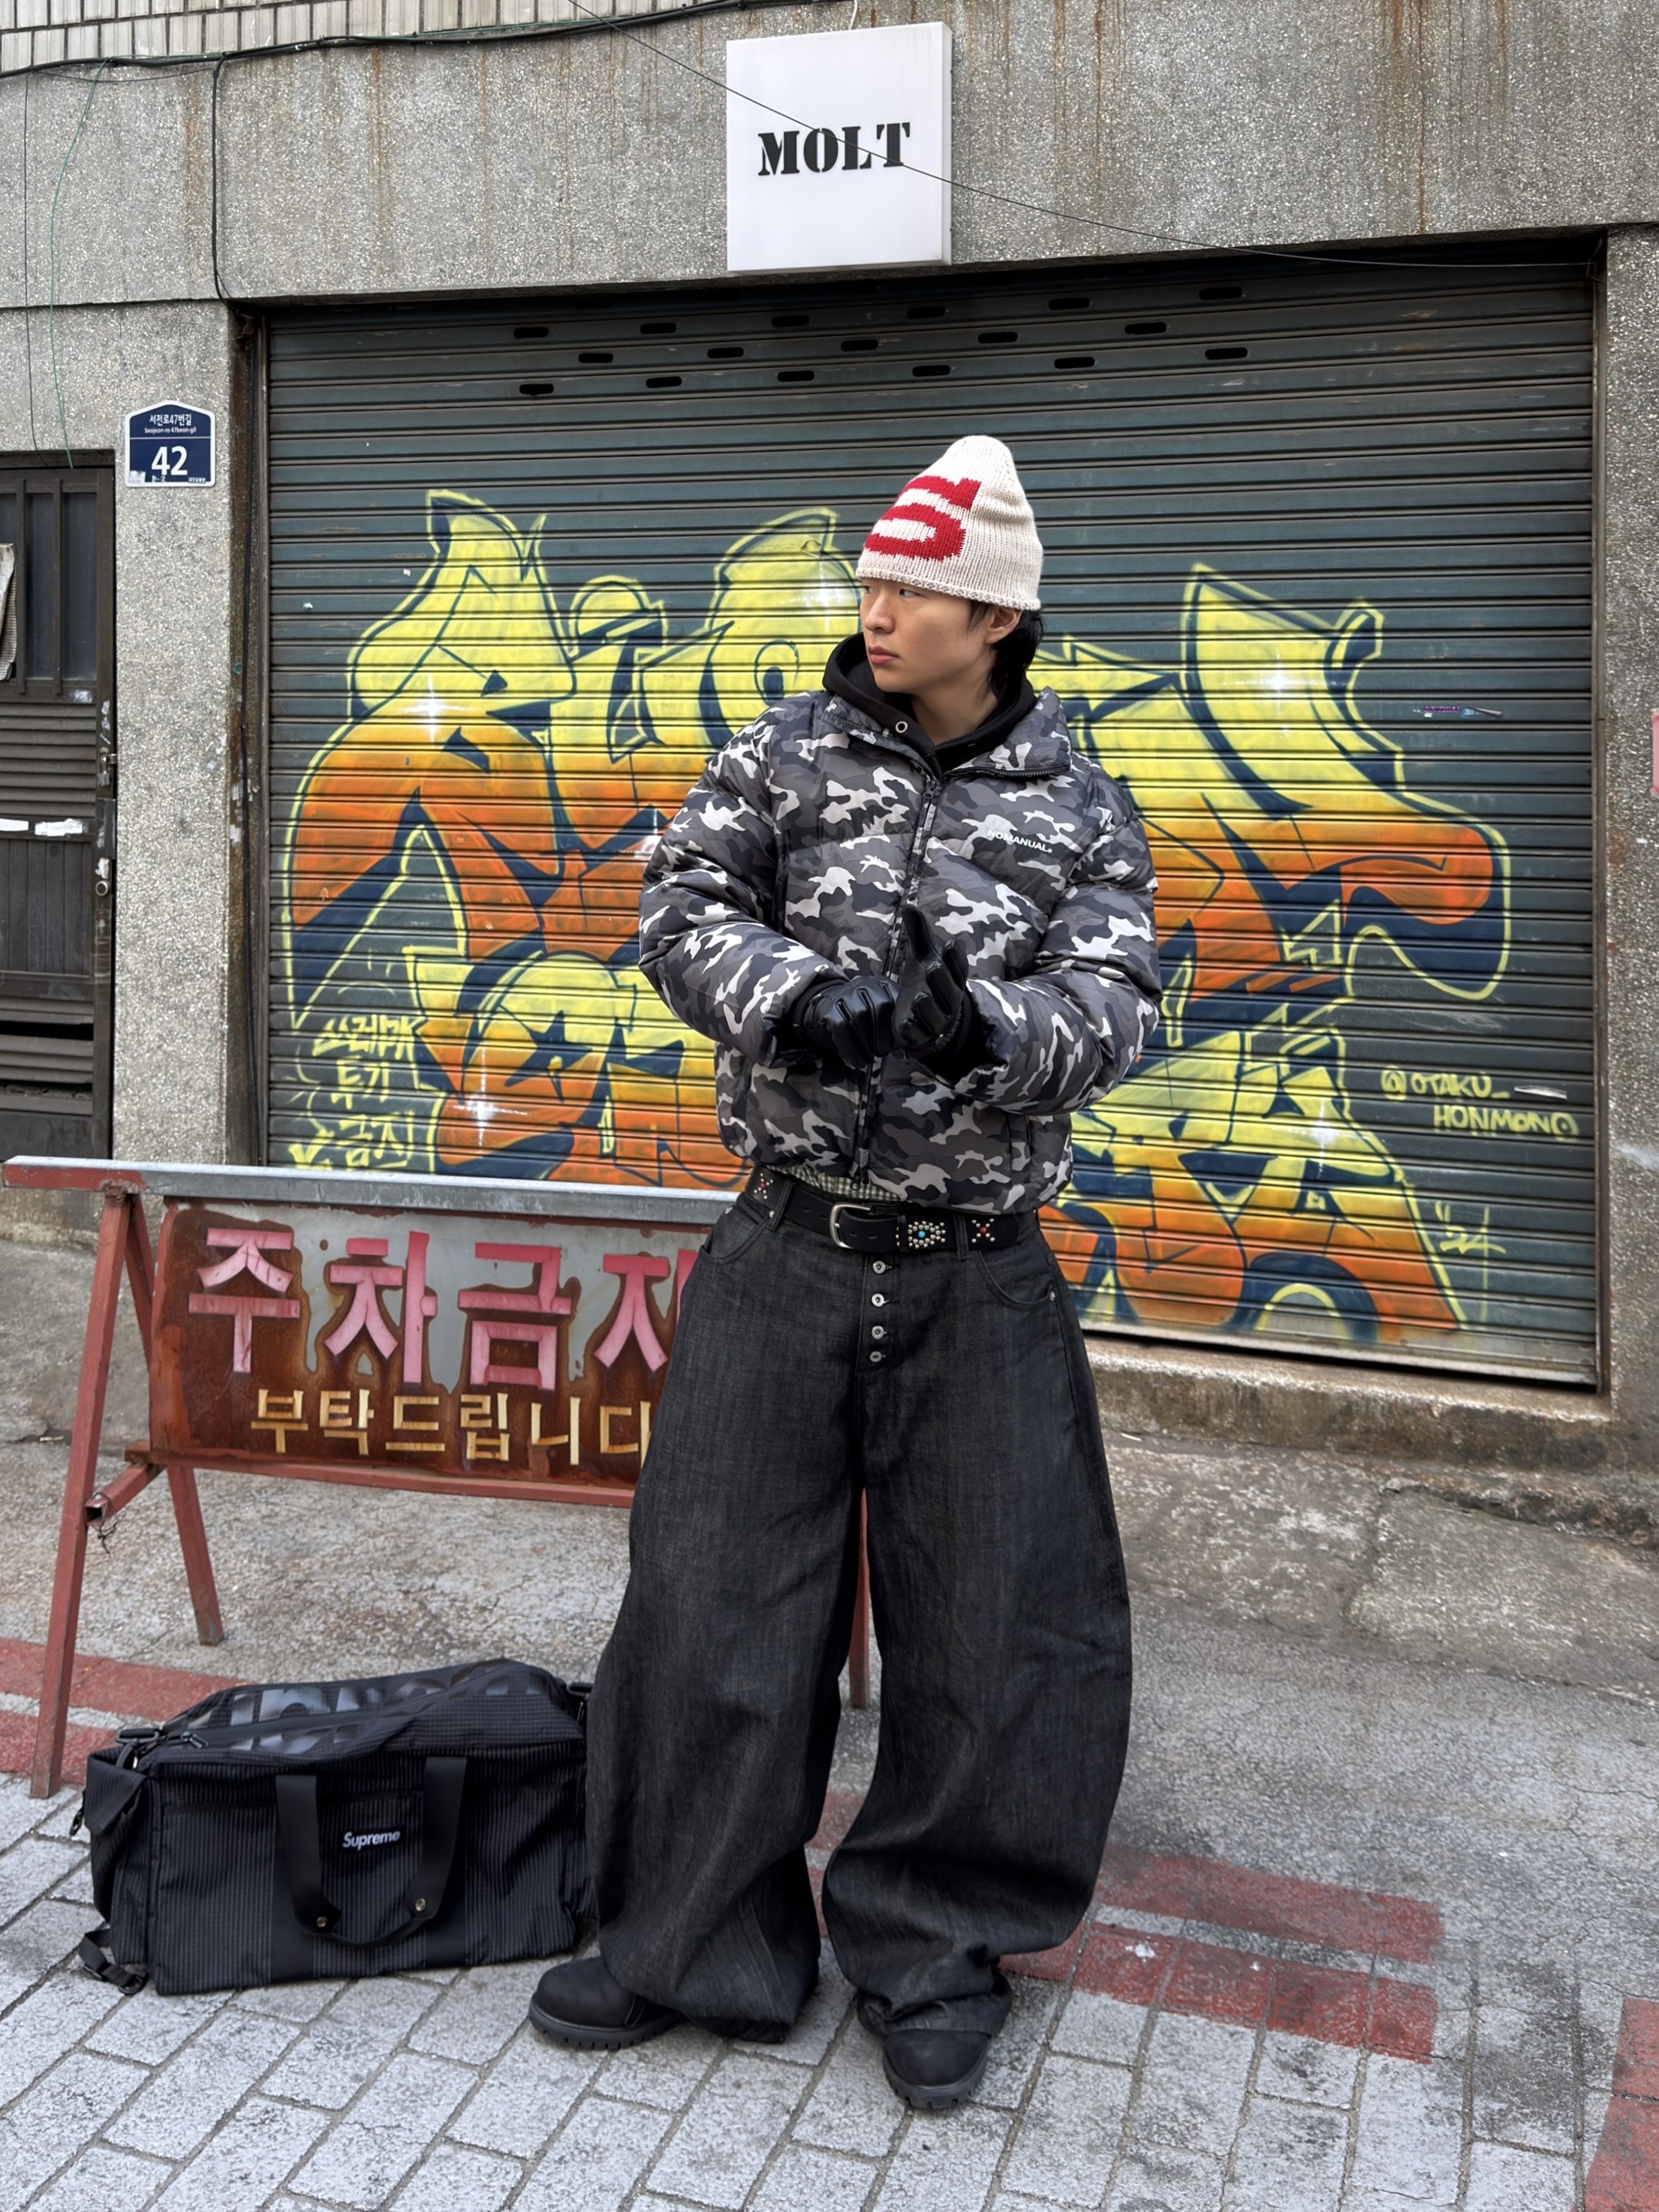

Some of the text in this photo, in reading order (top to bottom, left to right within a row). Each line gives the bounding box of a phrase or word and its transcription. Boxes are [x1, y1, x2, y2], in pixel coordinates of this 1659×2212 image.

[757, 122, 911, 176] MOLT
[149, 414, 192, 426] 서전로47번길
[151, 445, 188, 476] 42
[250, 1389, 652, 1470] 부탁드립니다
[342, 1831, 401, 1851] Supreme
